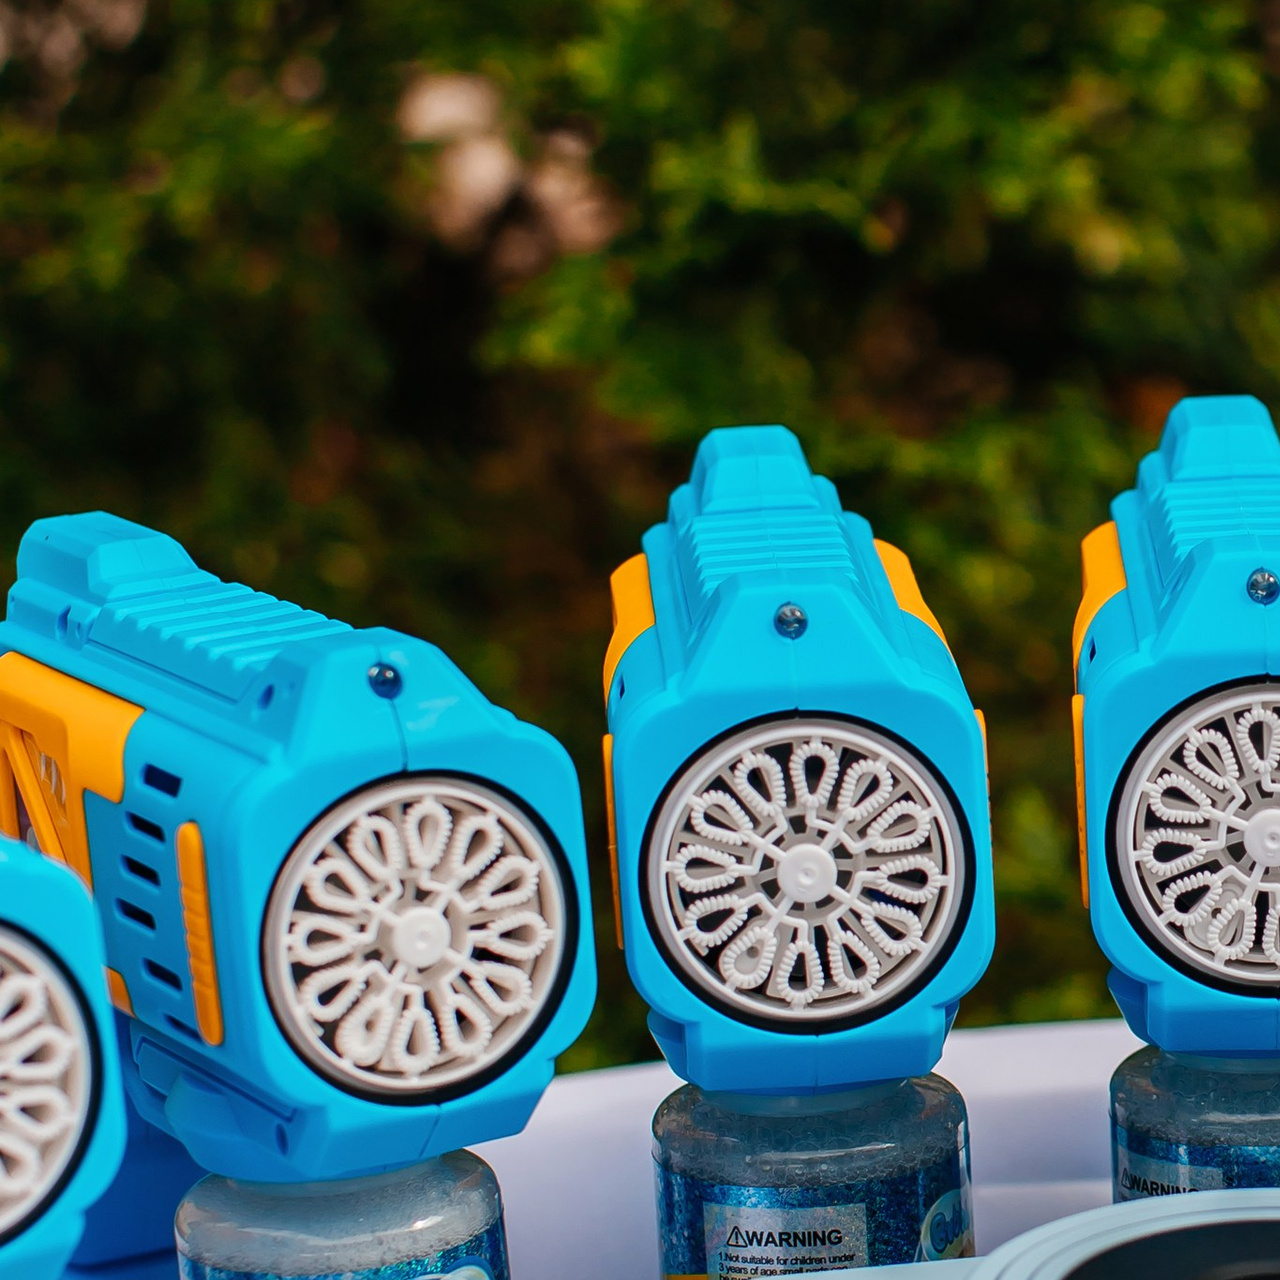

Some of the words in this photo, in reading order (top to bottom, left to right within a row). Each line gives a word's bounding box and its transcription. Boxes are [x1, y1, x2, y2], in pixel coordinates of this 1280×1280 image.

[1130, 1173, 1199, 1196] WARNIN
[745, 1229, 843, 1248] WARNING
[741, 1255, 775, 1265] suitable
[776, 1255, 790, 1266] for
[790, 1254, 827, 1265] children
[828, 1253, 856, 1263] under
[726, 1265, 749, 1275] years
[750, 1264, 759, 1275] of
